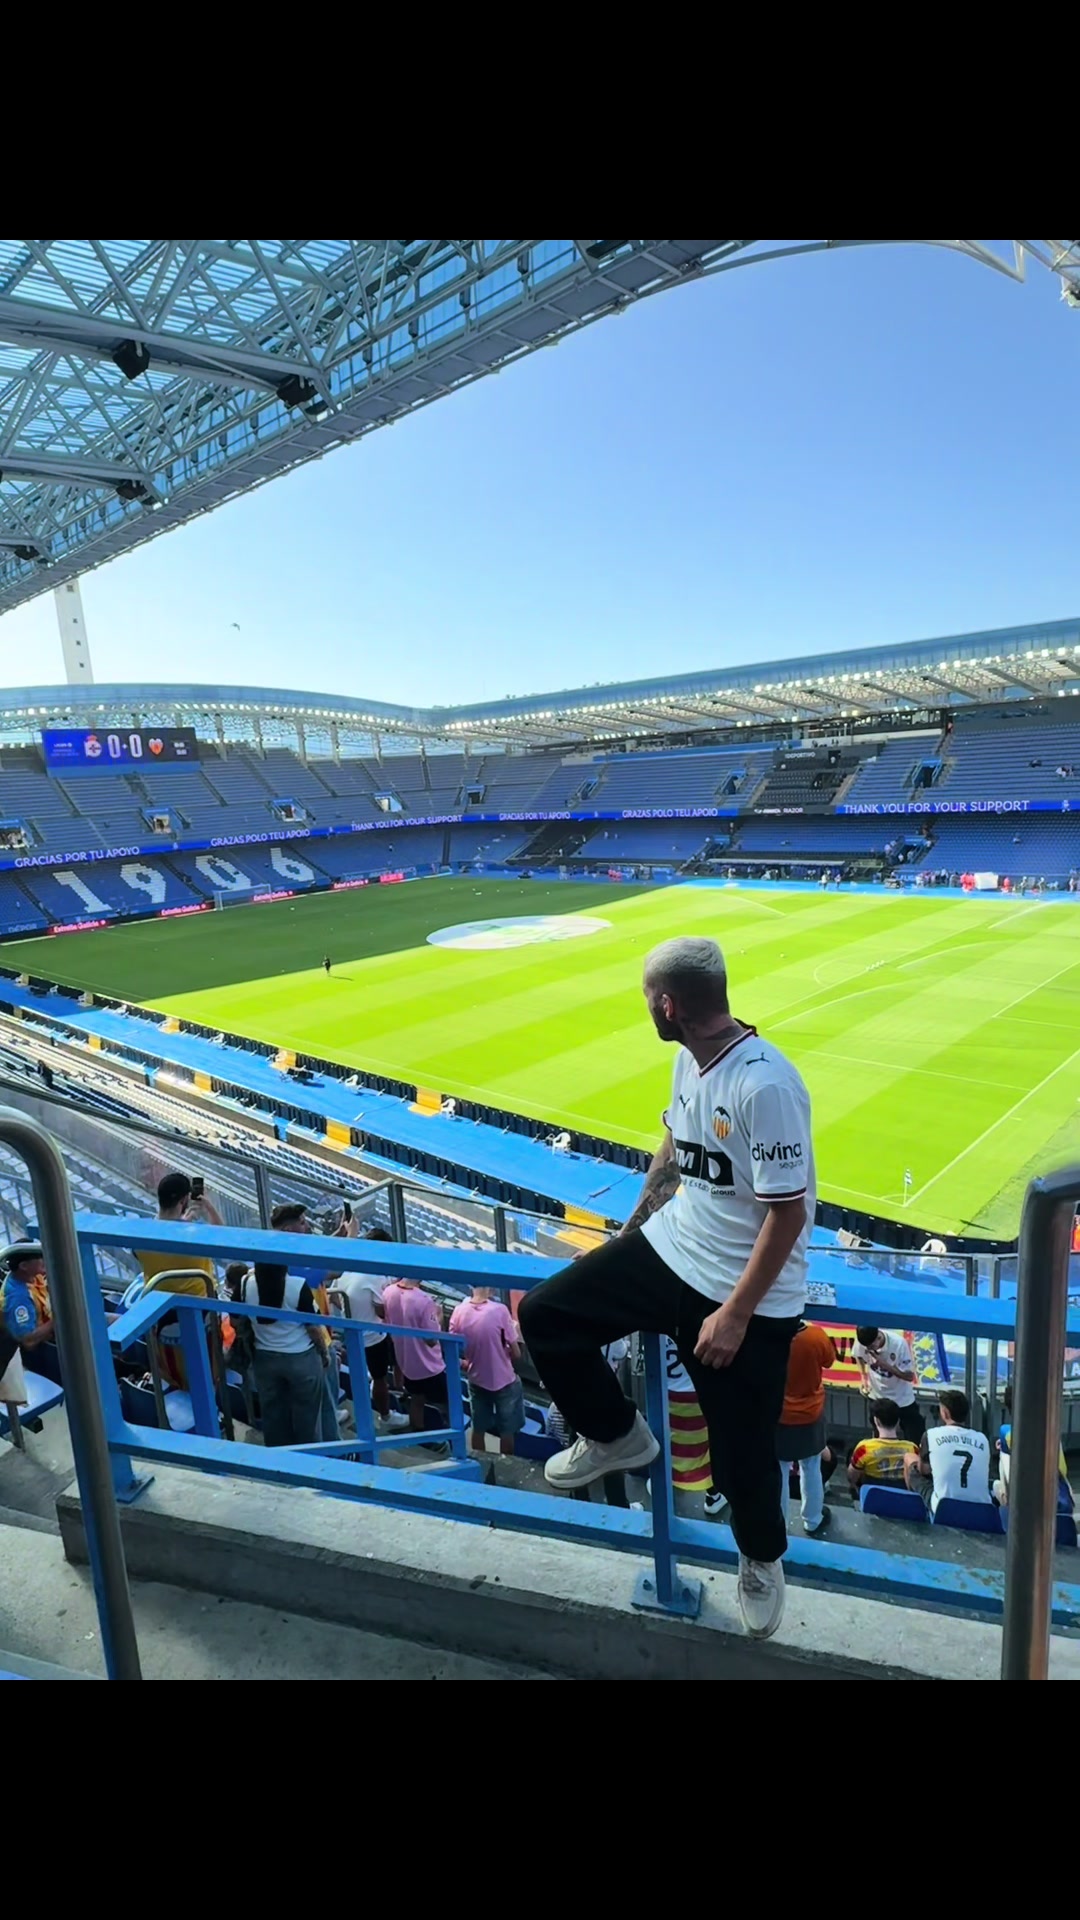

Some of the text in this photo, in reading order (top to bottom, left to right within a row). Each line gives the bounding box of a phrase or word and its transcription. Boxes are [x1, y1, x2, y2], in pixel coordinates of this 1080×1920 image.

[622, 807, 718, 818] GRAZAS POLO TEU APOIO
[844, 800, 1030, 814] THANK YOU FOR YOUR SUPPORT
[351, 814, 463, 831] THANK YOU FOR YOUR SUPPORT
[499, 811, 571, 821] GRACIAS POR TU APOYO
[210, 828, 311, 847] GRAZAS POLO TEU APOIO
[14, 846, 140, 868] GRACIAS POR TU APOYO
[751, 1141, 803, 1162] divina
[936, 1435, 985, 1451] DAVID VILLA
[952, 1449, 974, 1489] 7
